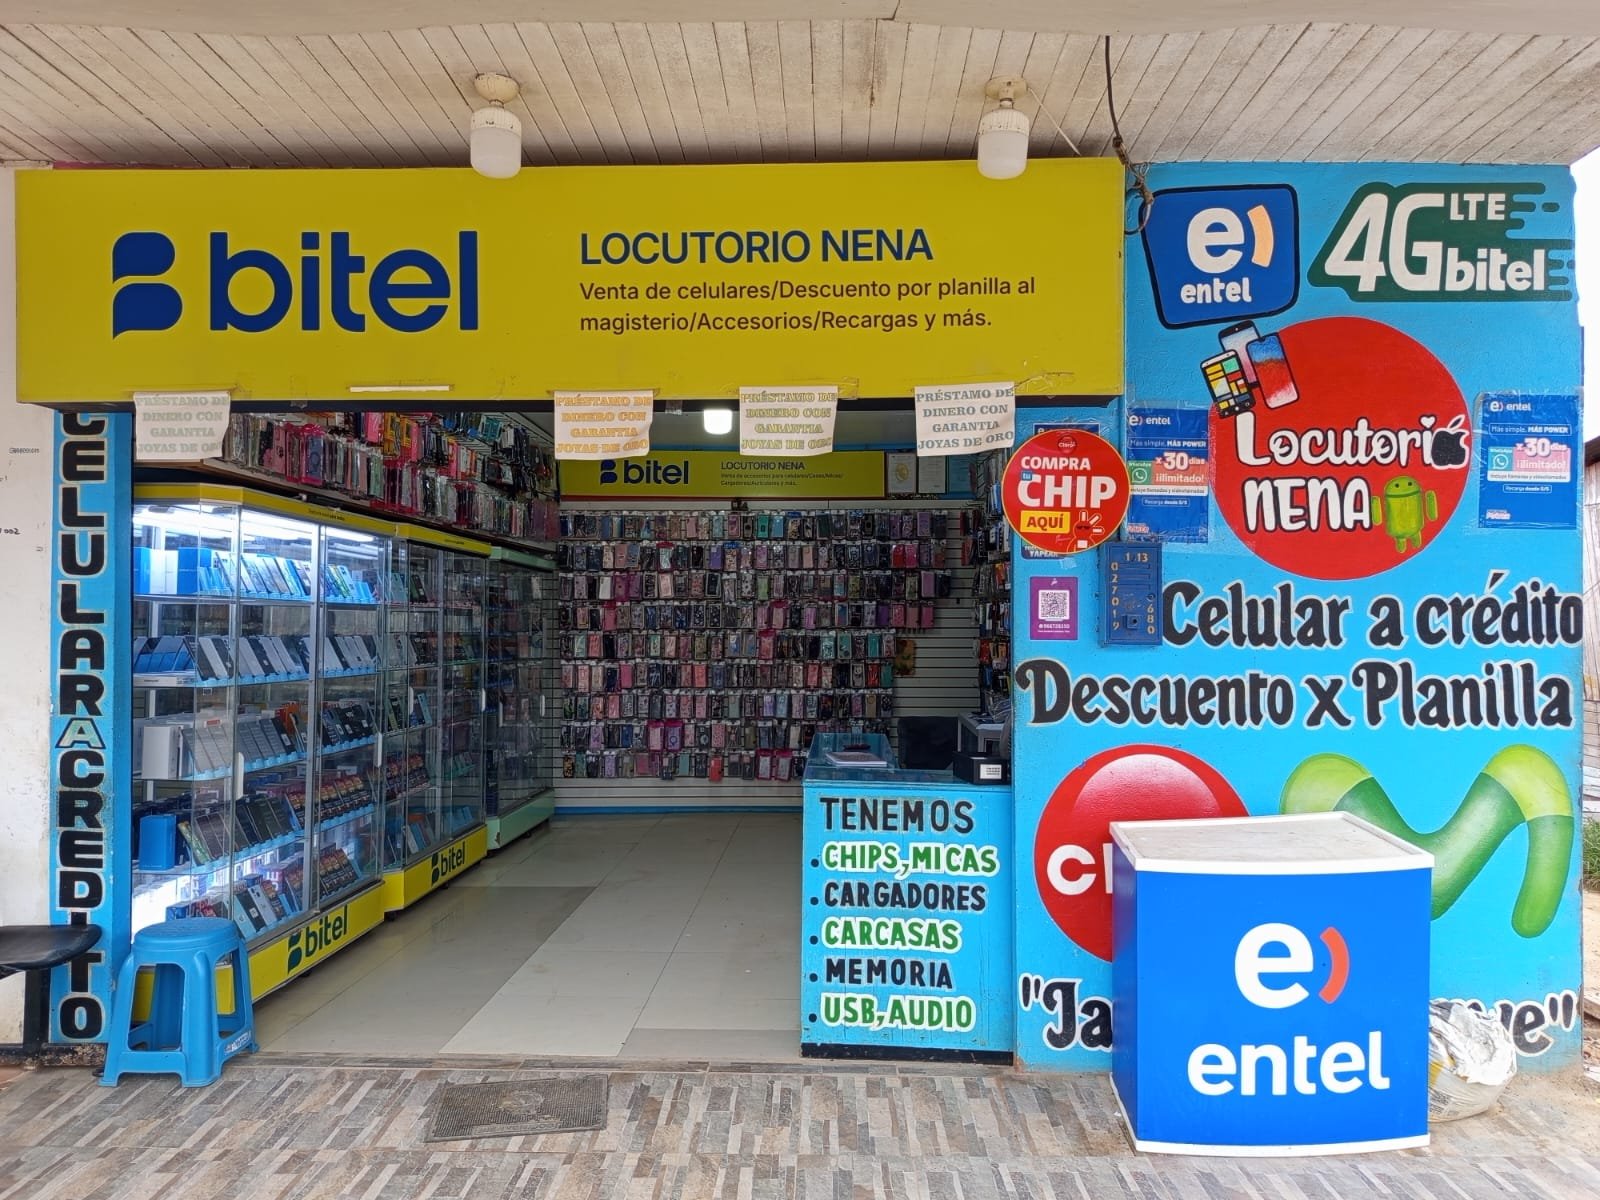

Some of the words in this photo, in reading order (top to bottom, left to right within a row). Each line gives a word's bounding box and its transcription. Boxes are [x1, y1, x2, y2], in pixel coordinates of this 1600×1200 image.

[1450, 193, 1506, 221] LTE
[581, 231, 811, 265] LOCUTORIO
[821, 229, 934, 262] NENA
[1324, 192, 1444, 292] 4G
[1445, 247, 1545, 291] bitel
[209, 231, 479, 333] bitel
[580, 282, 639, 300] Venta
[646, 282, 671, 299] de
[677, 280, 891, 301] celulares/Descuento
[897, 282, 932, 301] por
[938, 277, 1011, 300] planilla
[1018, 277, 1035, 294] al
[1181, 277, 1252, 304] entel
[580, 311, 918, 335] magisterio/Accesorios/Recargas
[924, 313, 936, 331] y
[943, 309, 992, 326] más.
[136, 394, 208, 406] PRÉSTAMO
[556, 394, 630, 406] PRÉSTAMO
[741, 390, 815, 403] PRÉSTAMO
[916, 389, 991, 402] PRÉSTAMO
[995, 388, 1014, 398] DE
[1506, 402, 1531, 411] entel
[143, 412, 192, 421] DINERO
[196, 411, 223, 421] CON
[561, 412, 615, 422] DINERO
[618, 411, 646, 421] CON
[745, 408, 800, 418] DINERO
[803, 407, 831, 417] CON
[923, 407, 976, 417] DINERO
[980, 404, 1008, 414] CON
[1146, 416, 1171, 425] entel
[932, 421, 1000, 432] GARANTIA
[137, 443, 176, 453] JOYAS
[180, 443, 197, 452] DE
[556, 443, 599, 453] JOYAS
[601, 443, 620, 453] DE
[623, 438, 648, 451] ORO
[786, 439, 804, 449] DE
[918, 439, 959, 449] JOYAS
[964, 437, 982, 448] DE
[985, 431, 1014, 443] ORO
[624, 460, 689, 485] bitel
[721, 461, 776, 470] LOCUTORIO
[778, 461, 805, 470] NENA
[1021, 456, 1092, 471] COMPRA
[1017, 473, 1117, 509] CHIP
[1027, 514, 1064, 531] AQUÍ
[1162, 581, 1350, 647] Celular
[1369, 596, 1404, 647] a
[1416, 572, 1584, 646] crédito
[1015, 659, 1294, 727] Descuento
[1305, 677, 1351, 728] x
[1352, 661, 1573, 728] Planilla
[55, 717, 106, 748] A
[820, 797, 974, 834] TENEMOS
[441, 841, 465, 877] bitel
[825, 881, 986, 911] CARGADORES
[305, 904, 348, 958] bitel
[825, 920, 959, 950] CARCASAS
[826, 958, 953, 989] MEMORIA
[1187, 1031, 1390, 1096] entel
